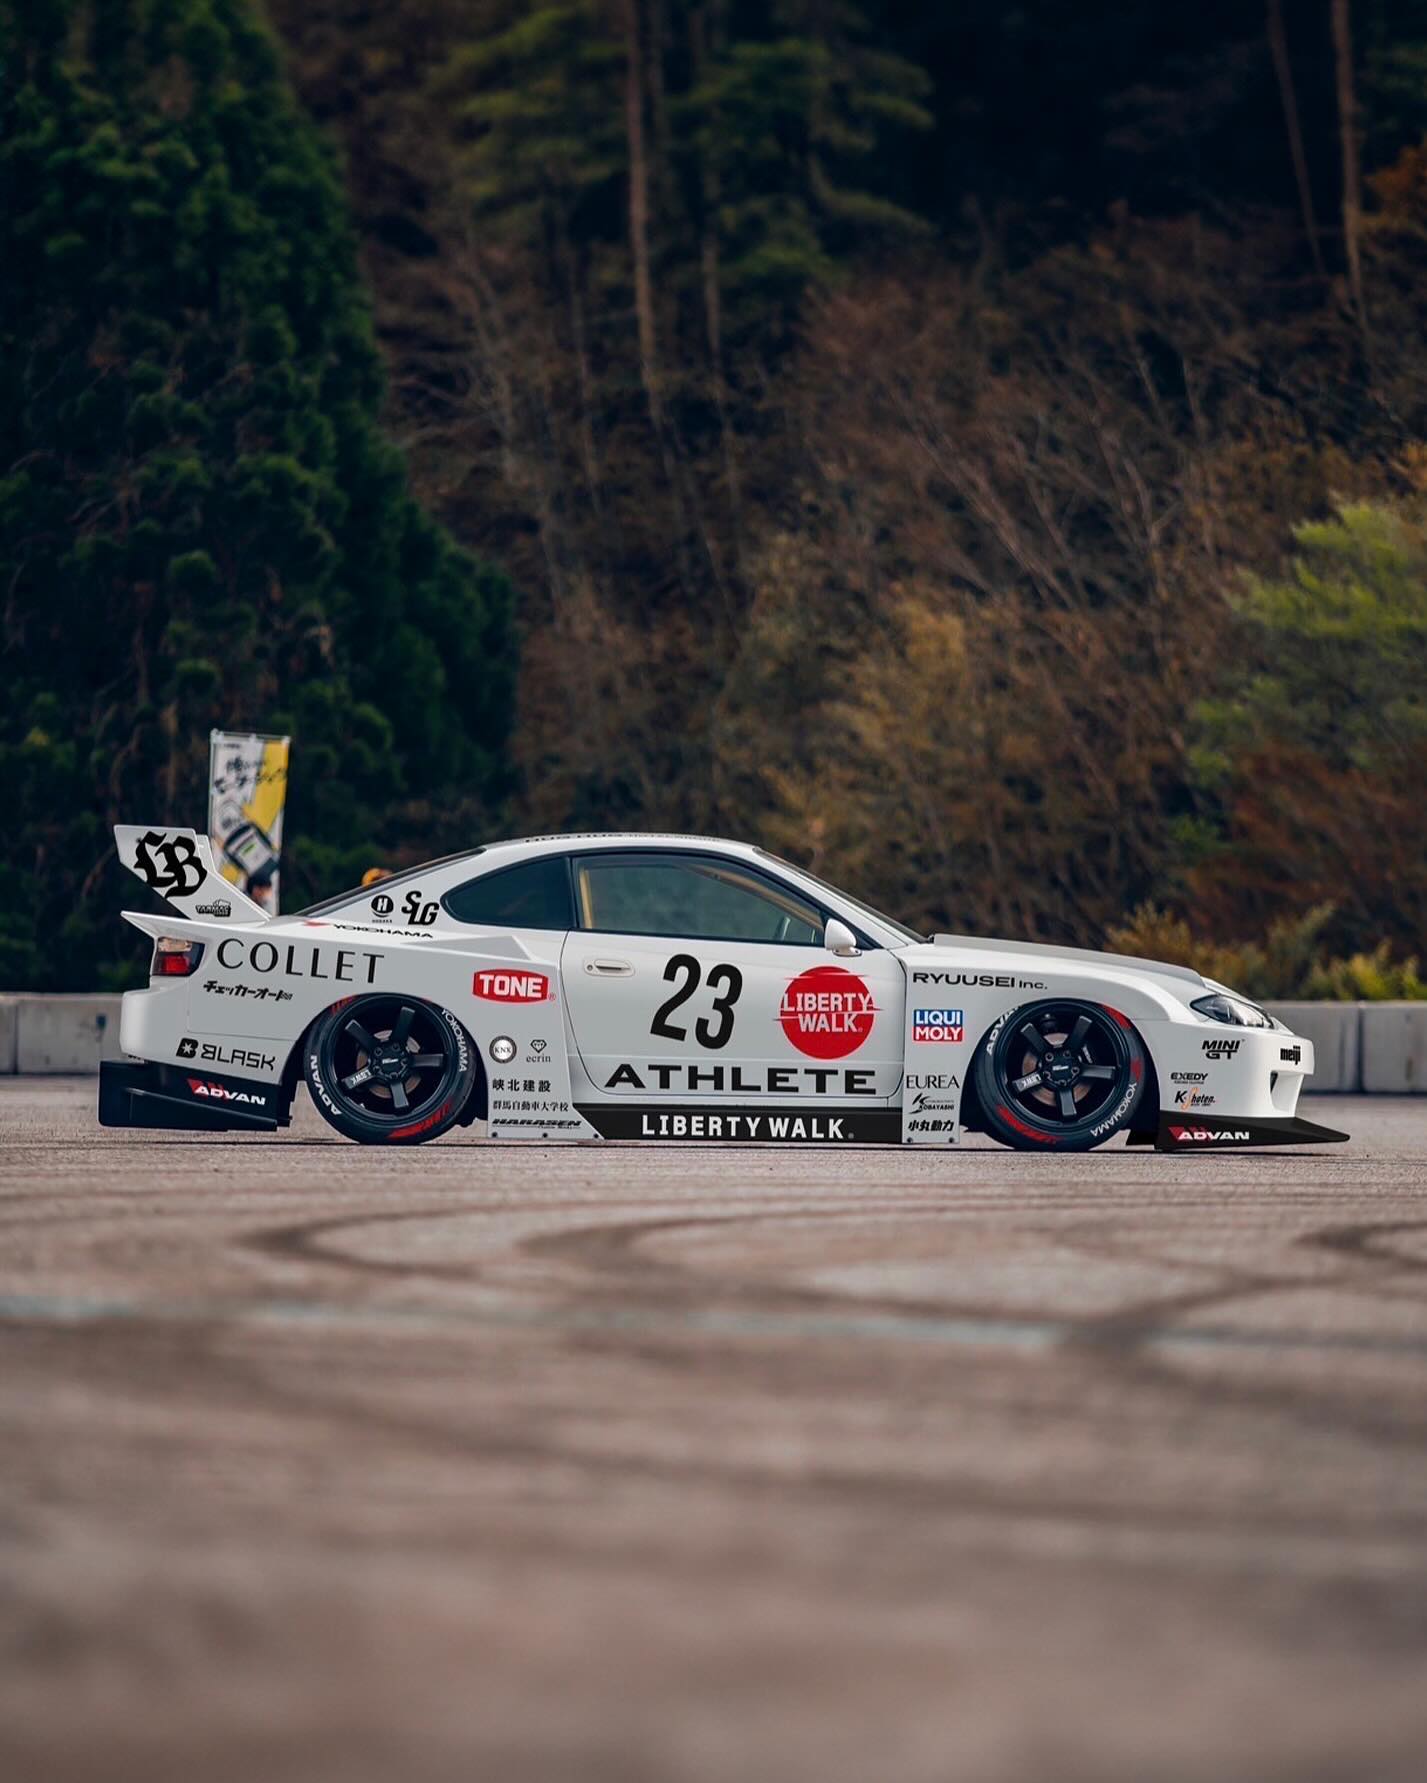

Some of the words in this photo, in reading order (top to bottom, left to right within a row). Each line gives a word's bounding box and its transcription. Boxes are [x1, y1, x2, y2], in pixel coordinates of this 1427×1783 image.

[334, 923, 433, 938] YOKOHAMA
[217, 938, 385, 984] COLLET
[479, 974, 543, 998] TONE
[912, 972, 1015, 988] RYUUSEI
[1019, 980, 1048, 990] Inc.
[650, 953, 743, 1050] 23
[783, 992, 871, 1013] LIBERTY
[798, 1013, 858, 1033] WALK
[915, 1010, 961, 1025] LIQUI
[441, 1008, 469, 1072] YOKOHAMA
[915, 1026, 963, 1042] MOLY
[1202, 1040, 1240, 1050] MINI
[1206, 1050, 1237, 1060] GT
[1280, 1045, 1301, 1065] meiji
[526, 1053, 551, 1063] ecrin
[310, 1055, 342, 1115] ADVAN
[604, 1064, 877, 1095] ATHLETE
[906, 1074, 960, 1089] EUREA
[1171, 1072, 1208, 1081] EXEDY
[194, 1086, 266, 1106] ADVAN
[1090, 1082, 1137, 1137] YOKOHAMA
[642, 1115, 763, 1137] LIBERTY
[768, 1116, 844, 1139] WALK
[1178, 1131, 1250, 1141] ADVAN
